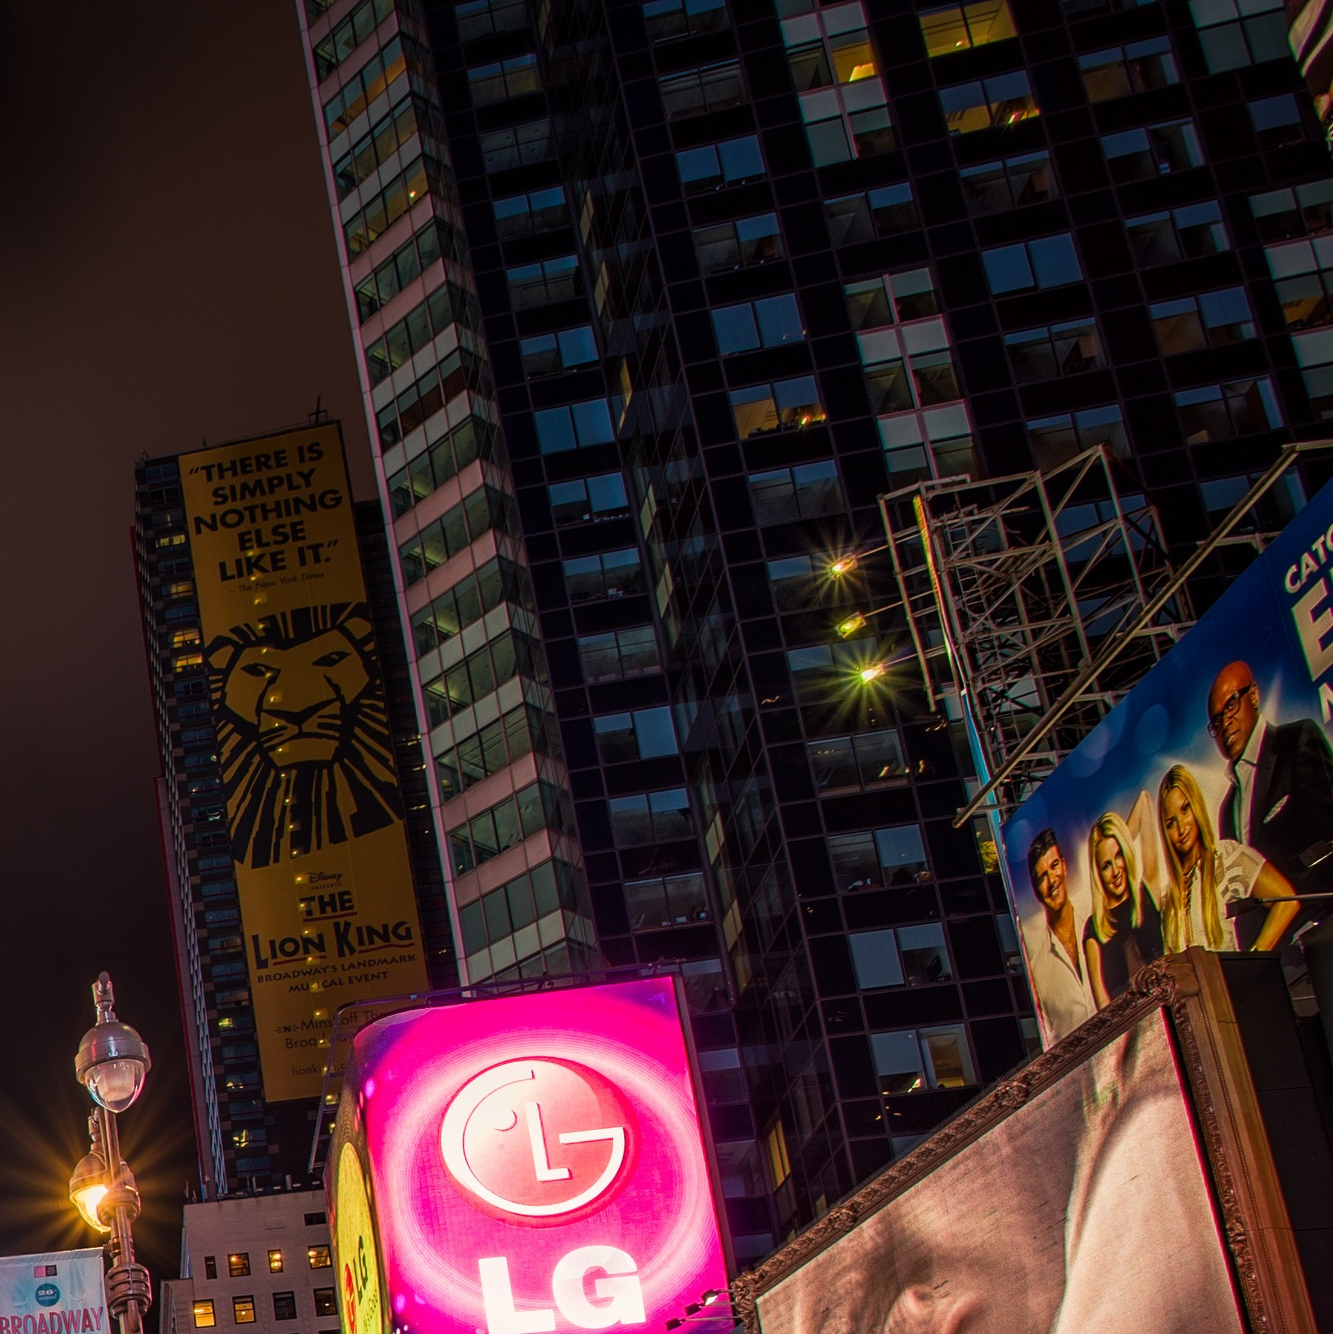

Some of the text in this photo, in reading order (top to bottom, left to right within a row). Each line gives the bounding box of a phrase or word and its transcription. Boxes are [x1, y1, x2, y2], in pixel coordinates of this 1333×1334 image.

[297, 441, 324, 465] IS
[212, 468, 317, 506] SIMPLY
[193, 489, 343, 535] NOTHING
[237, 520, 307, 552] ELSE
[218, 550, 287, 582] LIKE
[255, 580, 277, 589] New
[280, 576, 298, 586] York
[301, 572, 325, 582] Times
[299, 890, 354, 917] THE
[251, 920, 413, 970] LION KING
[341, 953, 416, 972] LANDMARK
[348, 972, 389, 986] EVENT
[351, 1235, 369, 1300] LG
